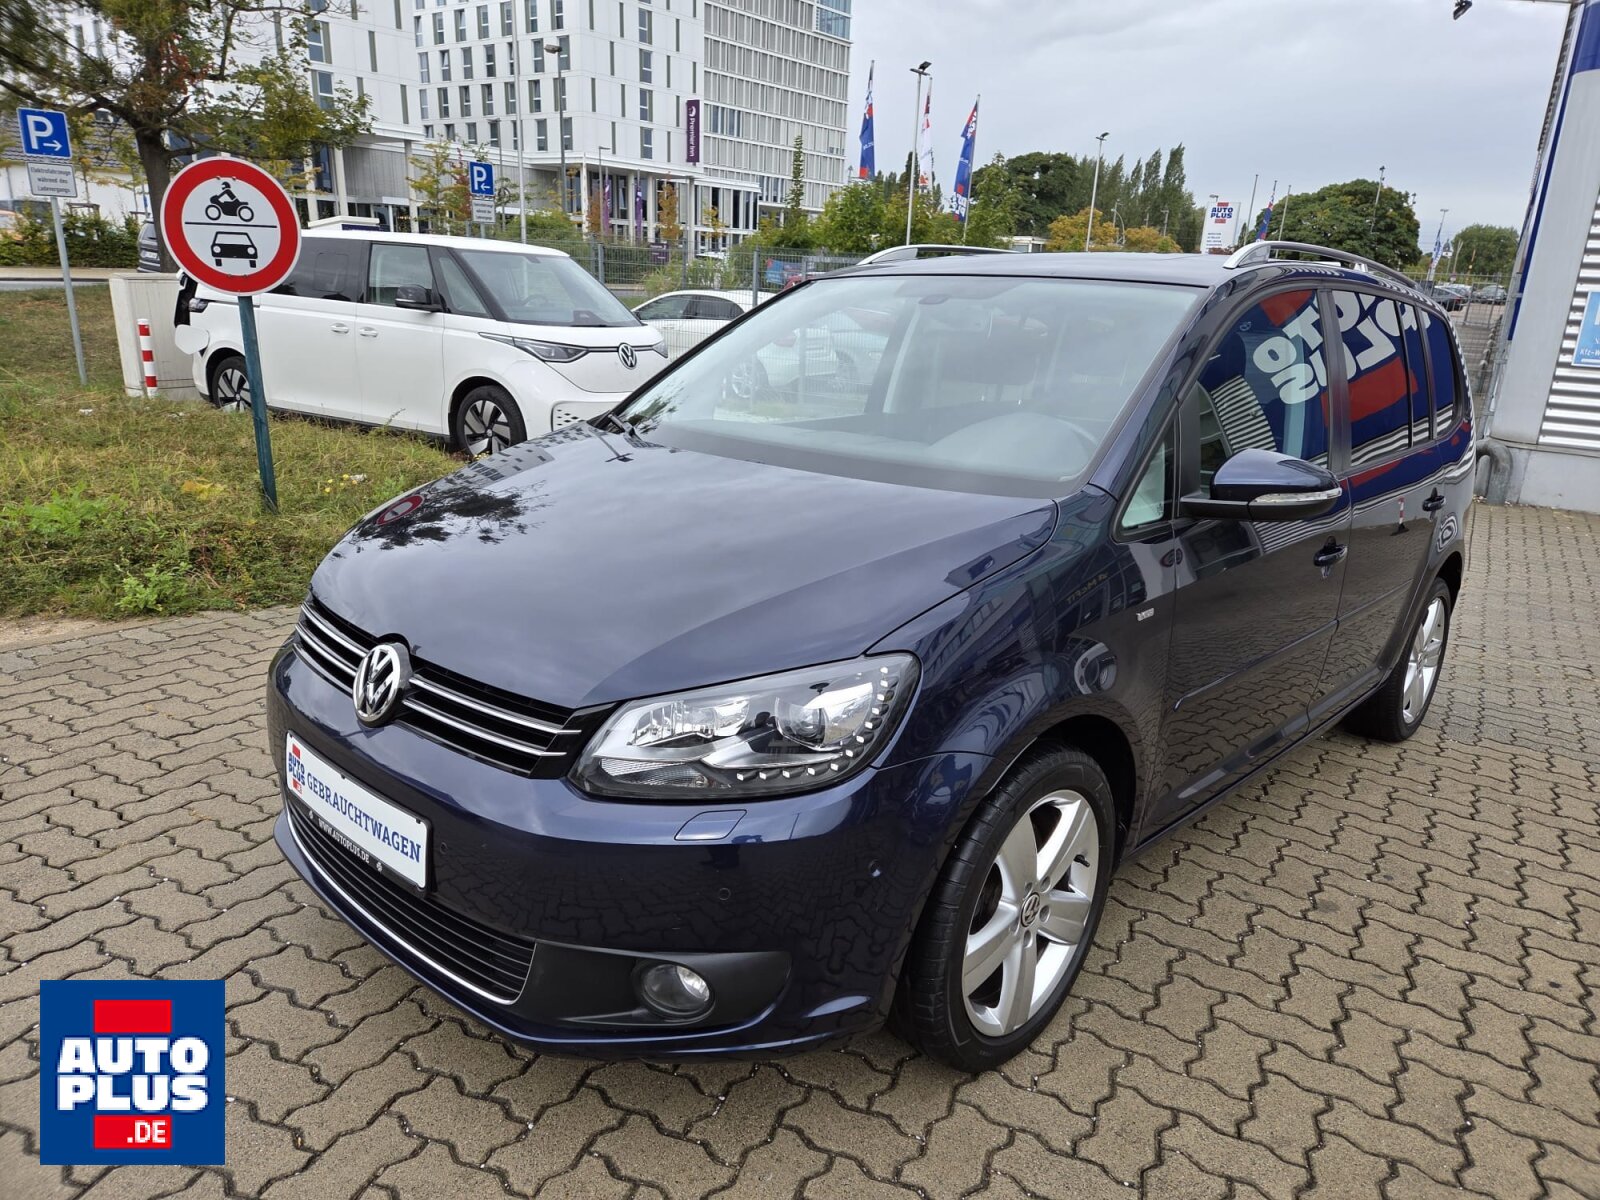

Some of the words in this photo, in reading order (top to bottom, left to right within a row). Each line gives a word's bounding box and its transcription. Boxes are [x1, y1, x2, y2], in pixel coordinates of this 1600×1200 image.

[26, 115, 54, 150] P
[473, 165, 487, 190] P
[288, 752, 305, 775] AUTO
[288, 763, 306, 786] PLUS
[307, 772, 422, 864] GEBRAUCHTWAGEN
[318, 817, 370, 865] WWW.AUTOPLUS.DE
